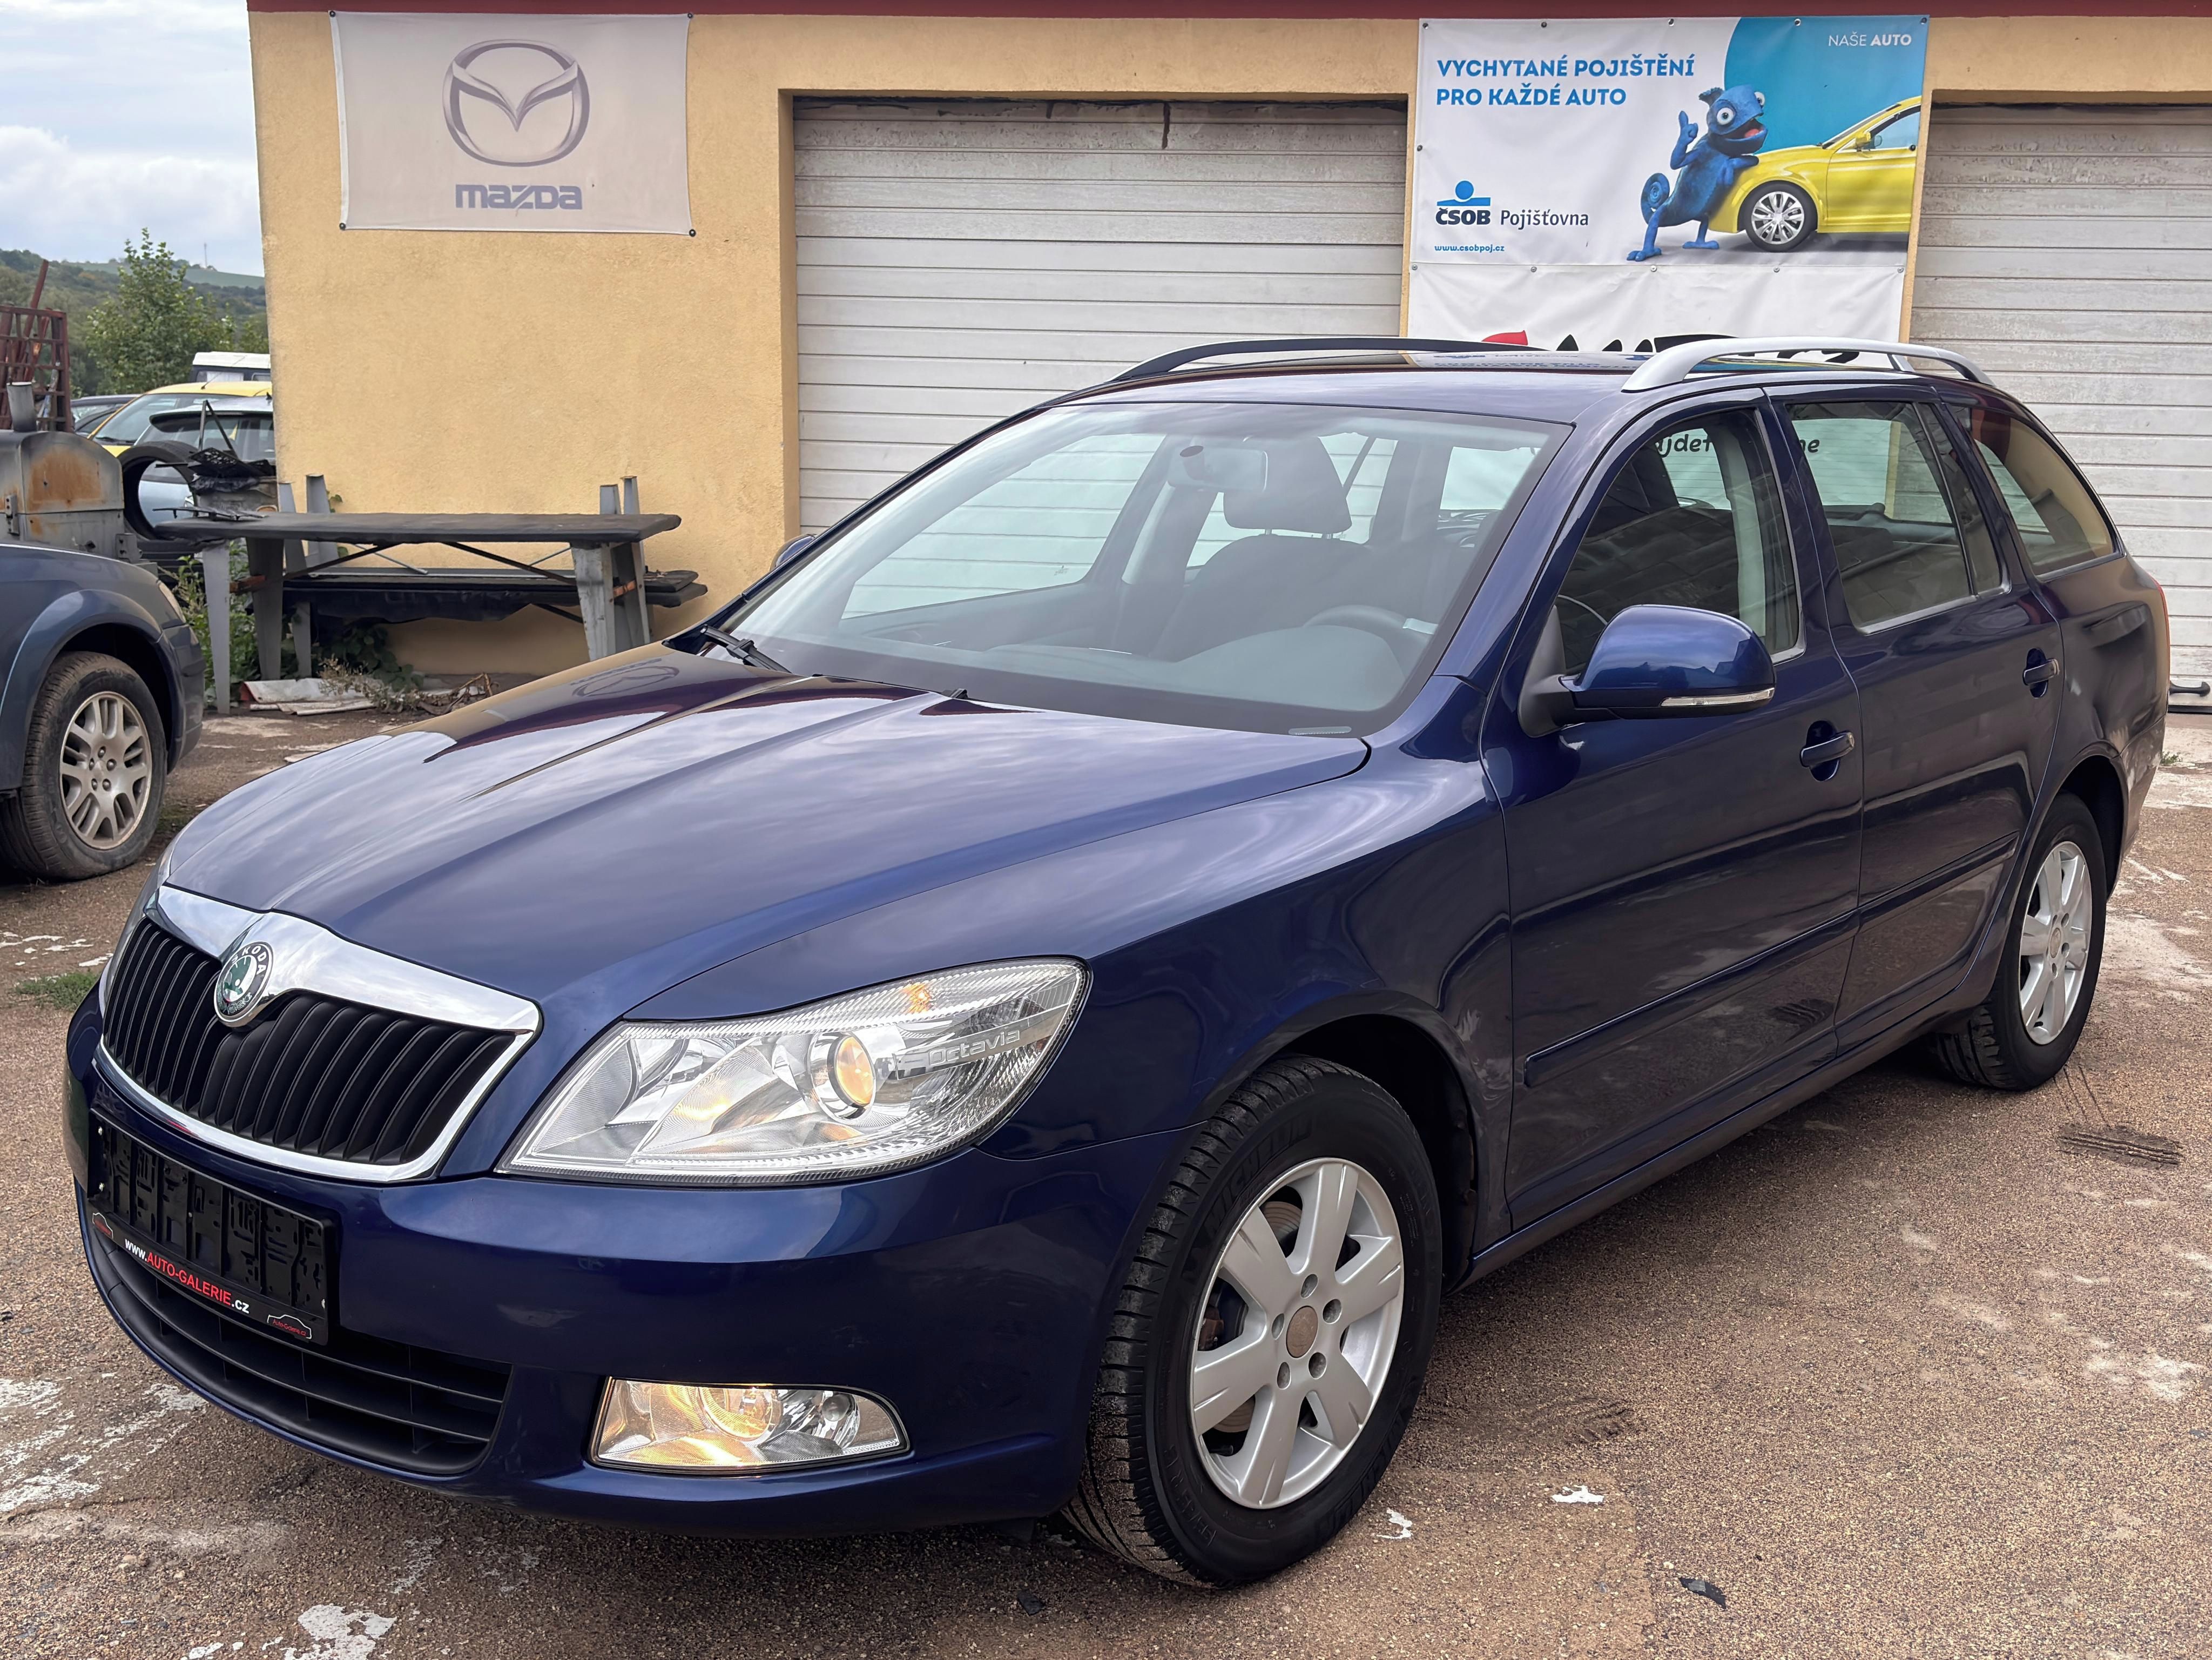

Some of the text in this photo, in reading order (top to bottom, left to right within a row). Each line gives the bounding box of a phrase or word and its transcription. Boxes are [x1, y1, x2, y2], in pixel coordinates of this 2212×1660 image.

[1828, 31, 1912, 46] NAŠE AUTO
[1437, 53, 1696, 77] VYCHYTANÉ POJIŠTĚNÍ
[1436, 82, 1627, 106] PRO KAŽDÉ AUTO
[455, 184, 583, 210] mazda
[1435, 207, 1589, 230] ČSOB Pojišťovna
[1434, 244, 1505, 253] www.csobpoj.cz
[929, 1029, 1020, 1066] Octavia
[125, 1238, 249, 1314] www.AUTO-GALERIE.cz
